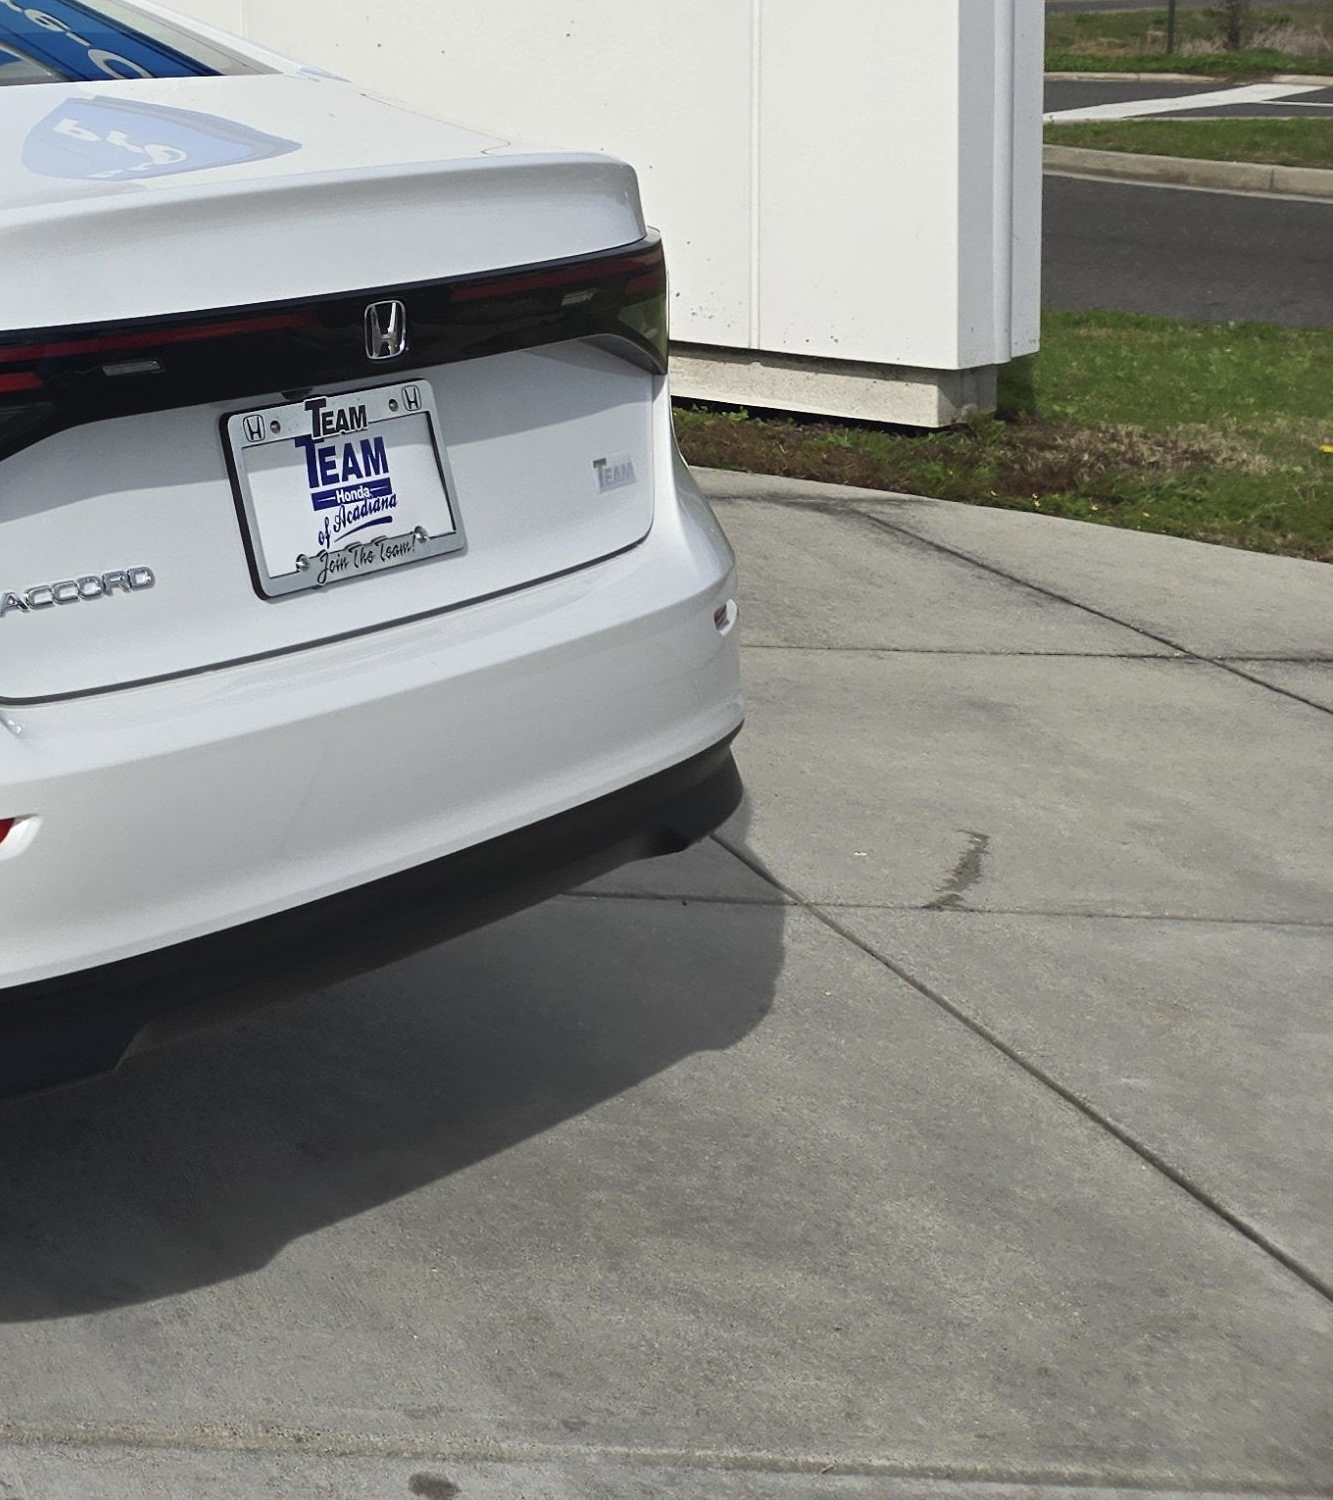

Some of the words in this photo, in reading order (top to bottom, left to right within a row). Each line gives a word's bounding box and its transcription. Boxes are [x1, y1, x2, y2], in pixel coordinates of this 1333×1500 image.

[304, 399, 368, 437] TEAM
[295, 435, 389, 488] TEAM
[593, 457, 635, 492] TEAM
[336, 487, 369, 503] Honda
[318, 516, 330, 549] of
[333, 493, 397, 533] Acadiana
[317, 551, 348, 584] Join
[348, 541, 374, 567] The
